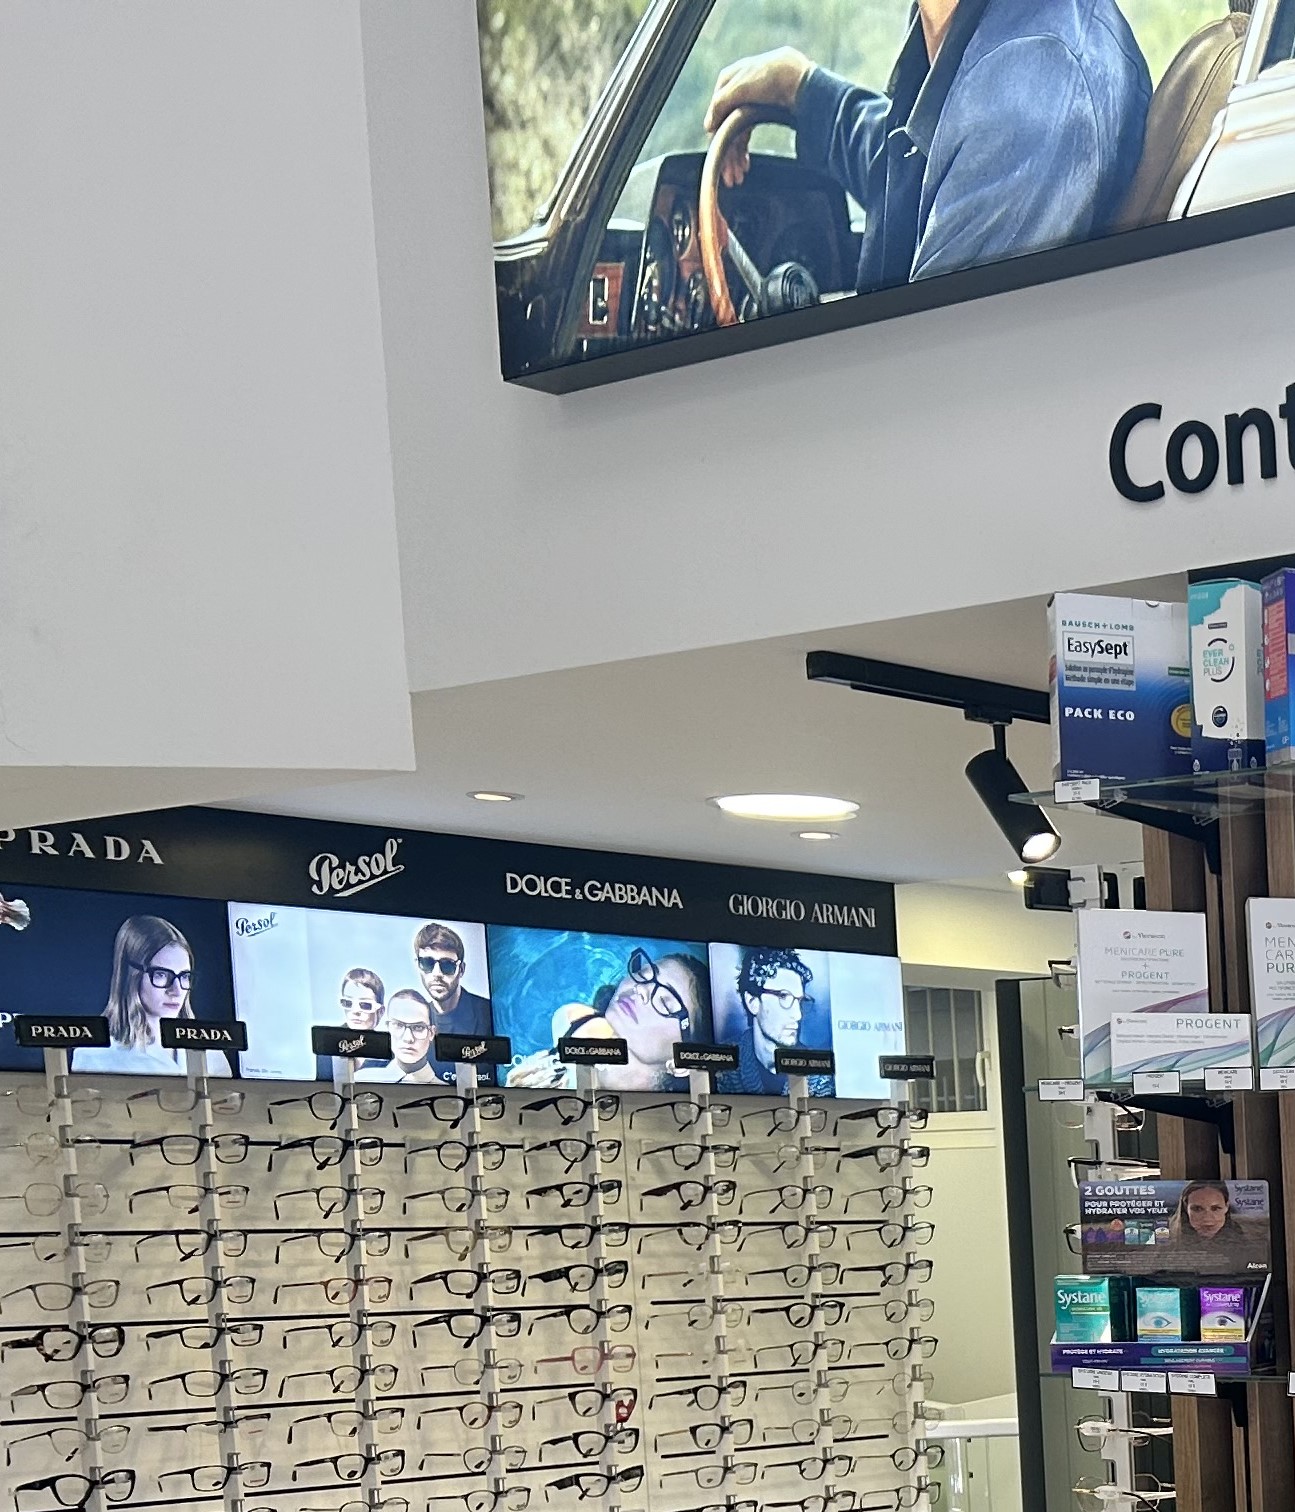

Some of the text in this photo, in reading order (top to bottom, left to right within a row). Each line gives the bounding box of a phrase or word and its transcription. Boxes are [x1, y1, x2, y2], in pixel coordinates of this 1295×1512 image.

[1067, 637, 1129, 659] EasySept
[1202, 657, 1230, 667] CLEAN
[1064, 707, 1135, 721] PACK ECO
[0, 829, 164, 865] PRADA
[308, 838, 405, 897] Persol
[728, 893, 876, 928] GIORGIO ARMANI
[235, 911, 279, 938] Persol
[1104, 947, 1185, 957] MENICARE PURE
[1121, 971, 1170, 980] PROGENT
[838, 1020, 871, 1031] GIORGIO
[1176, 1018, 1241, 1029] PROGENT
[31, 1025, 93, 1039] PRADA
[175, 1027, 232, 1041] PRADA
[1084, 1185, 1156, 1196] 2 GOUTTES
[1057, 1290, 1106, 1309] Systane
[1203, 1290, 1242, 1304] Systane
